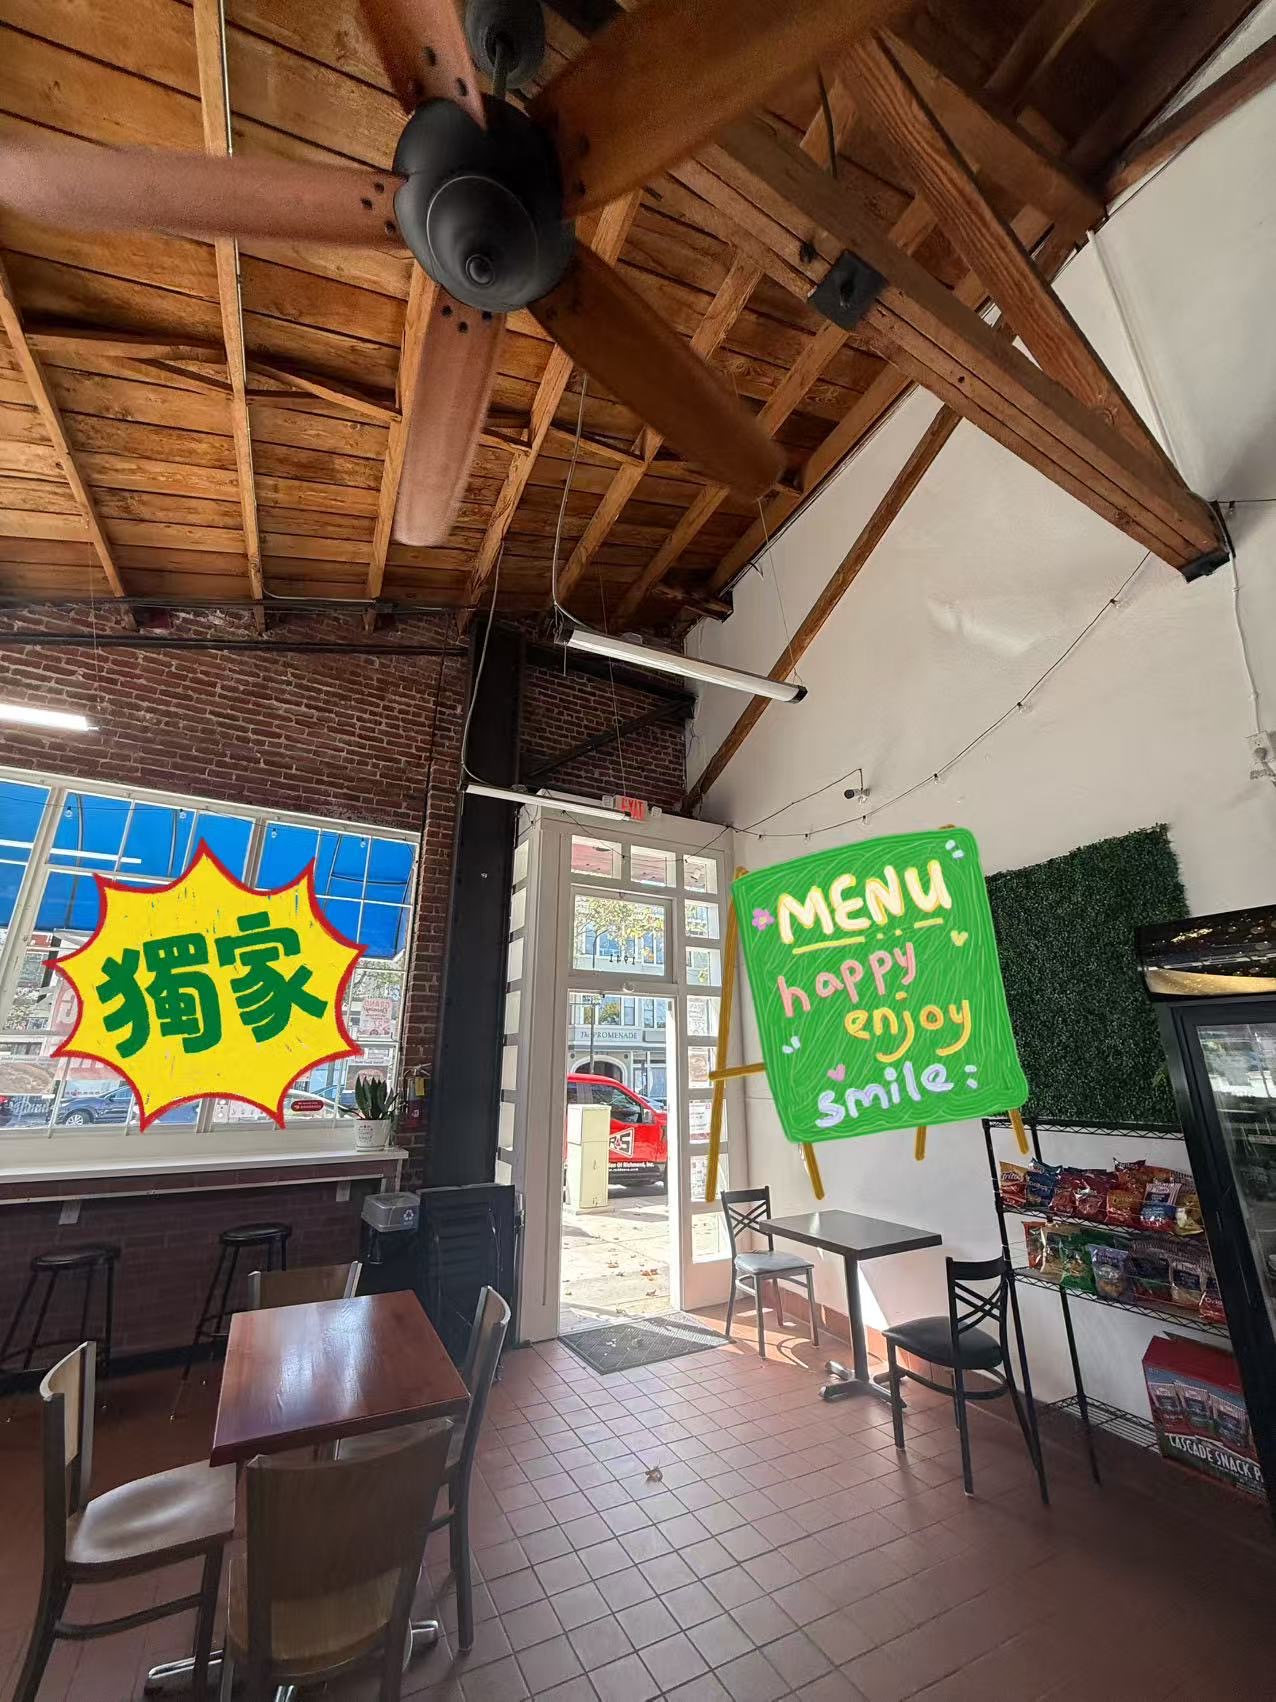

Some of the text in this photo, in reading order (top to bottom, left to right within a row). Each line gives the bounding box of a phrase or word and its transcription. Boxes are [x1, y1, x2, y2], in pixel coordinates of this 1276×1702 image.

[621, 797, 645, 820] EXIT
[593, 1031, 638, 1040] PROMENADE
[1168, 1434, 1214, 1461] CASCADE
[1214, 1451, 1251, 1478] SNACK
